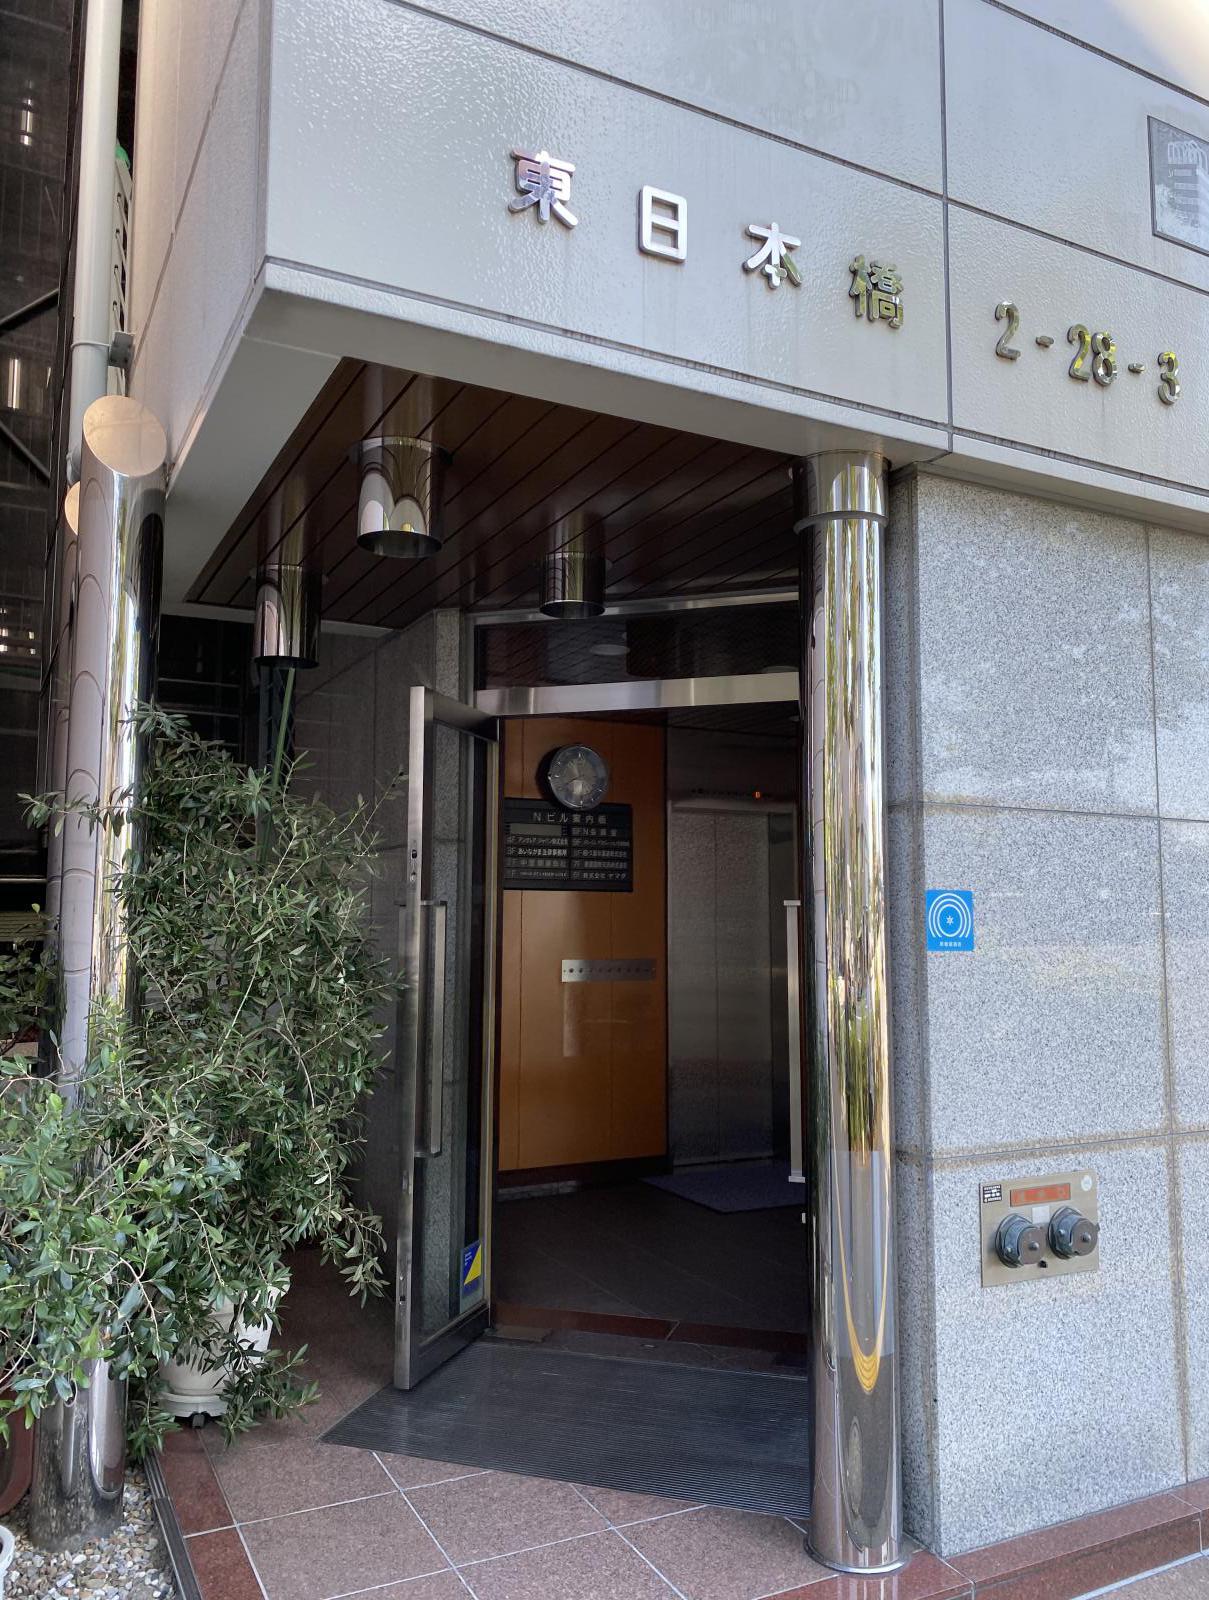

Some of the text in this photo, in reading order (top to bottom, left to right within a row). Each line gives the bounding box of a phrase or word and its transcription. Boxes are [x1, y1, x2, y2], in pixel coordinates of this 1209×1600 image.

[509, 150, 1182, 405] 東日本橋 2-28-3
